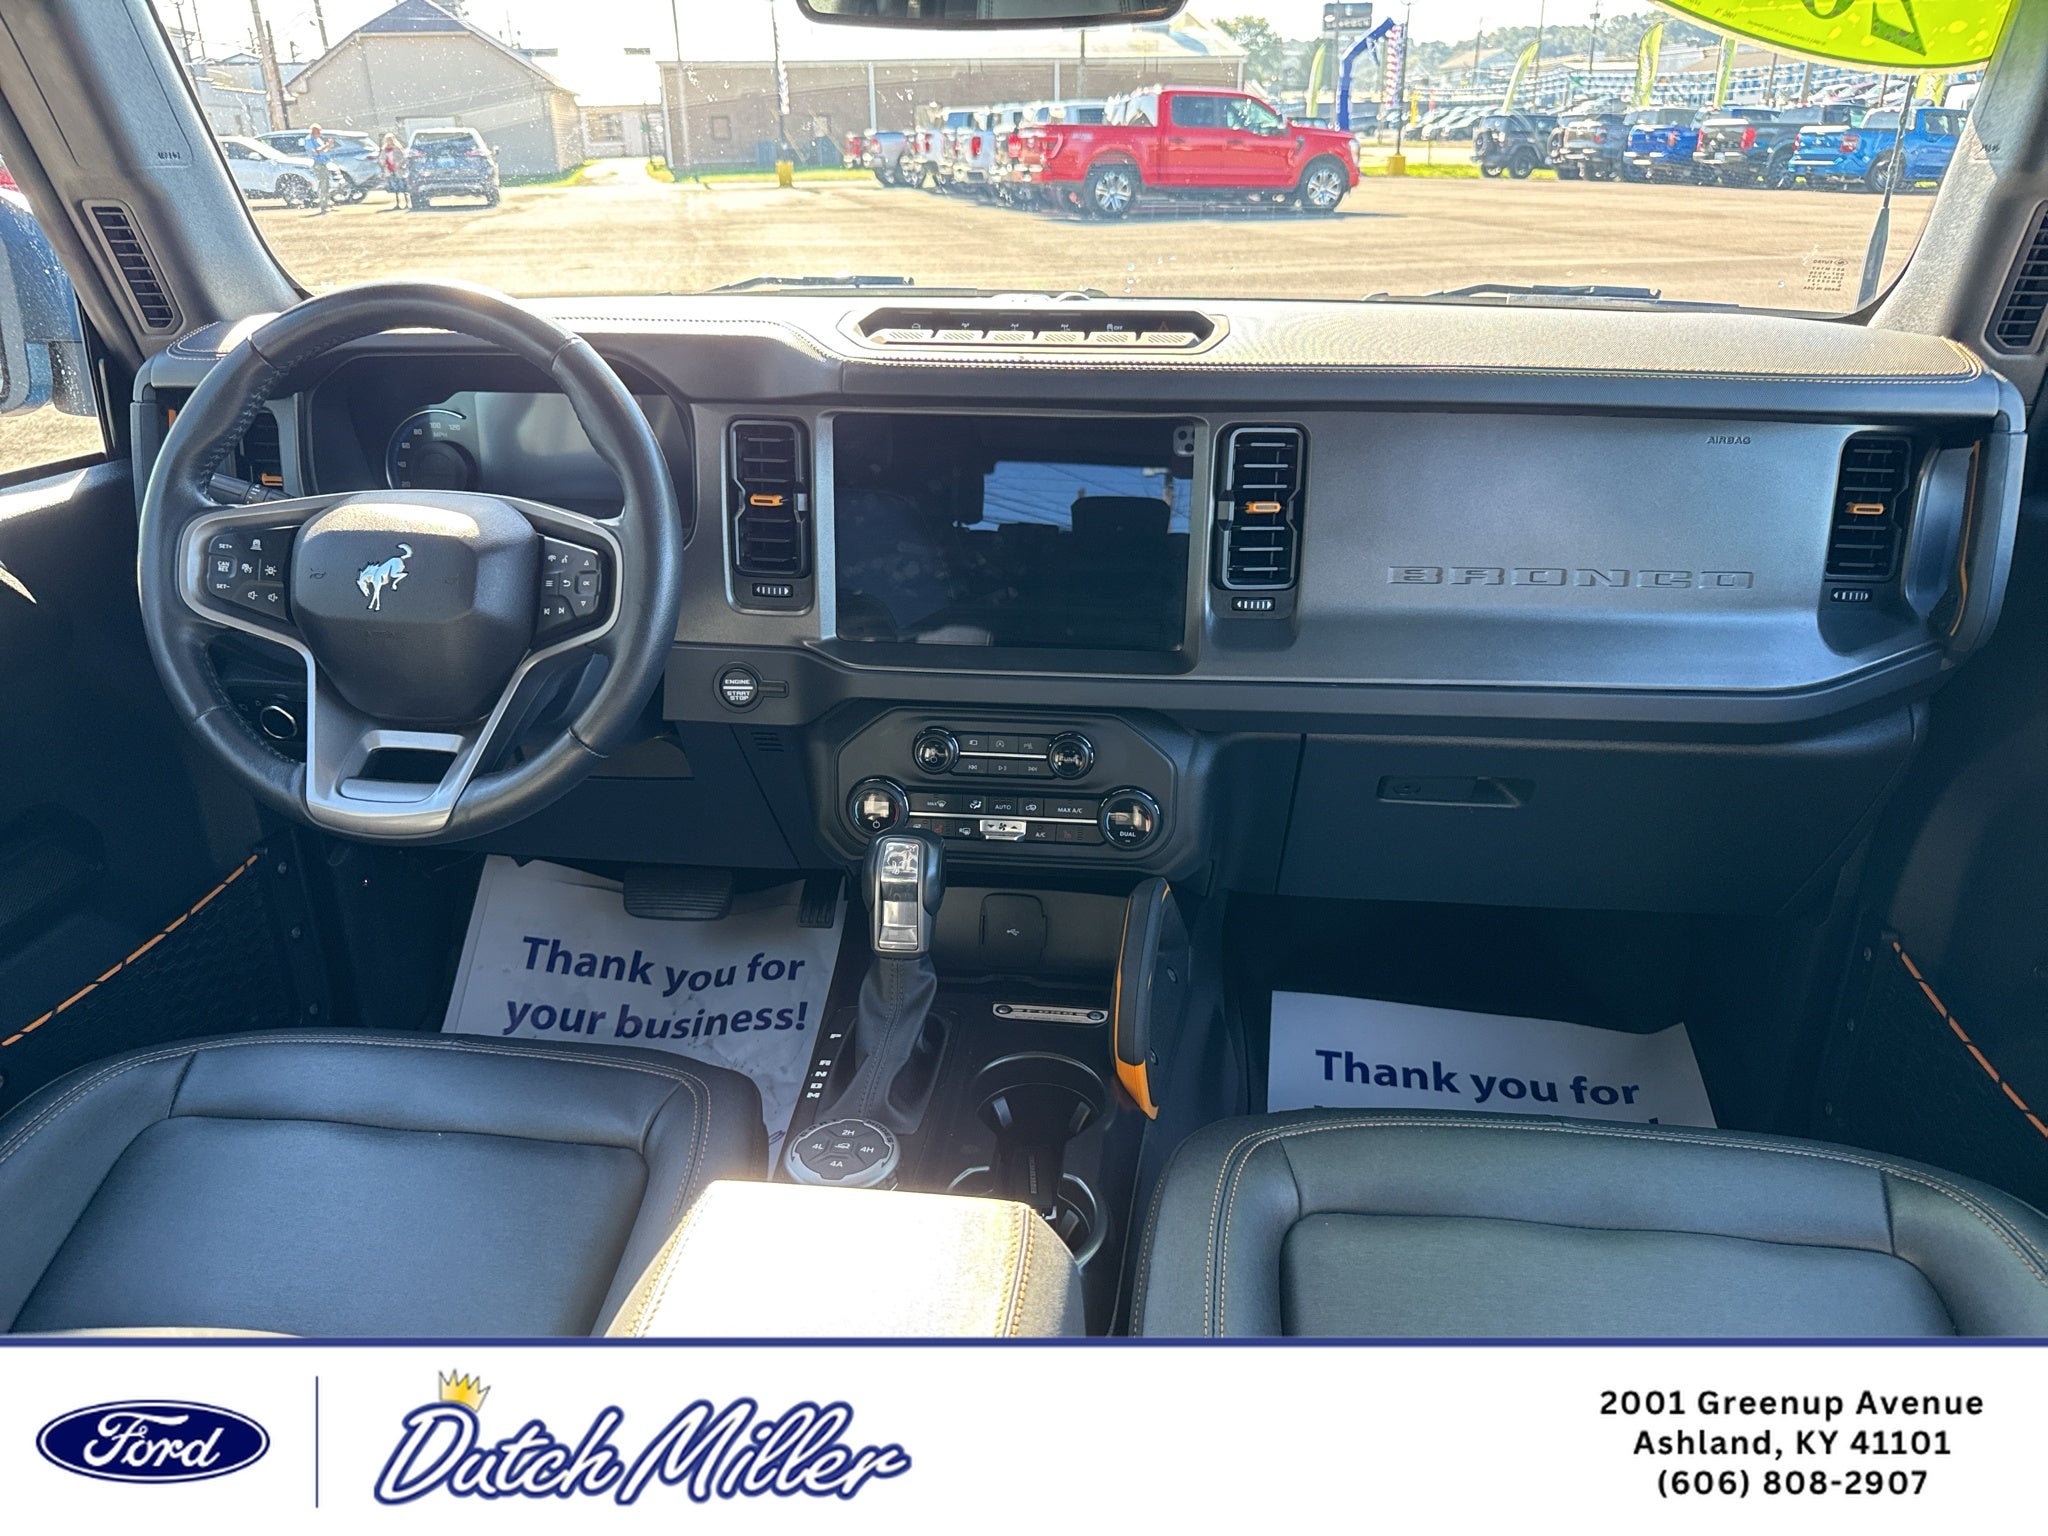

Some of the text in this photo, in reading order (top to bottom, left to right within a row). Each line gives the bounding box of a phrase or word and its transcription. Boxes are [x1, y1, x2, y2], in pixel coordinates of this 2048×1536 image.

[1705, 436, 1751, 445] AIRBAG
[1387, 566, 1754, 589] BRONCO
[523, 936, 805, 997] Thank you for
[502, 1001, 808, 1039] your business!
[1315, 1049, 1640, 1105] Thank you for
